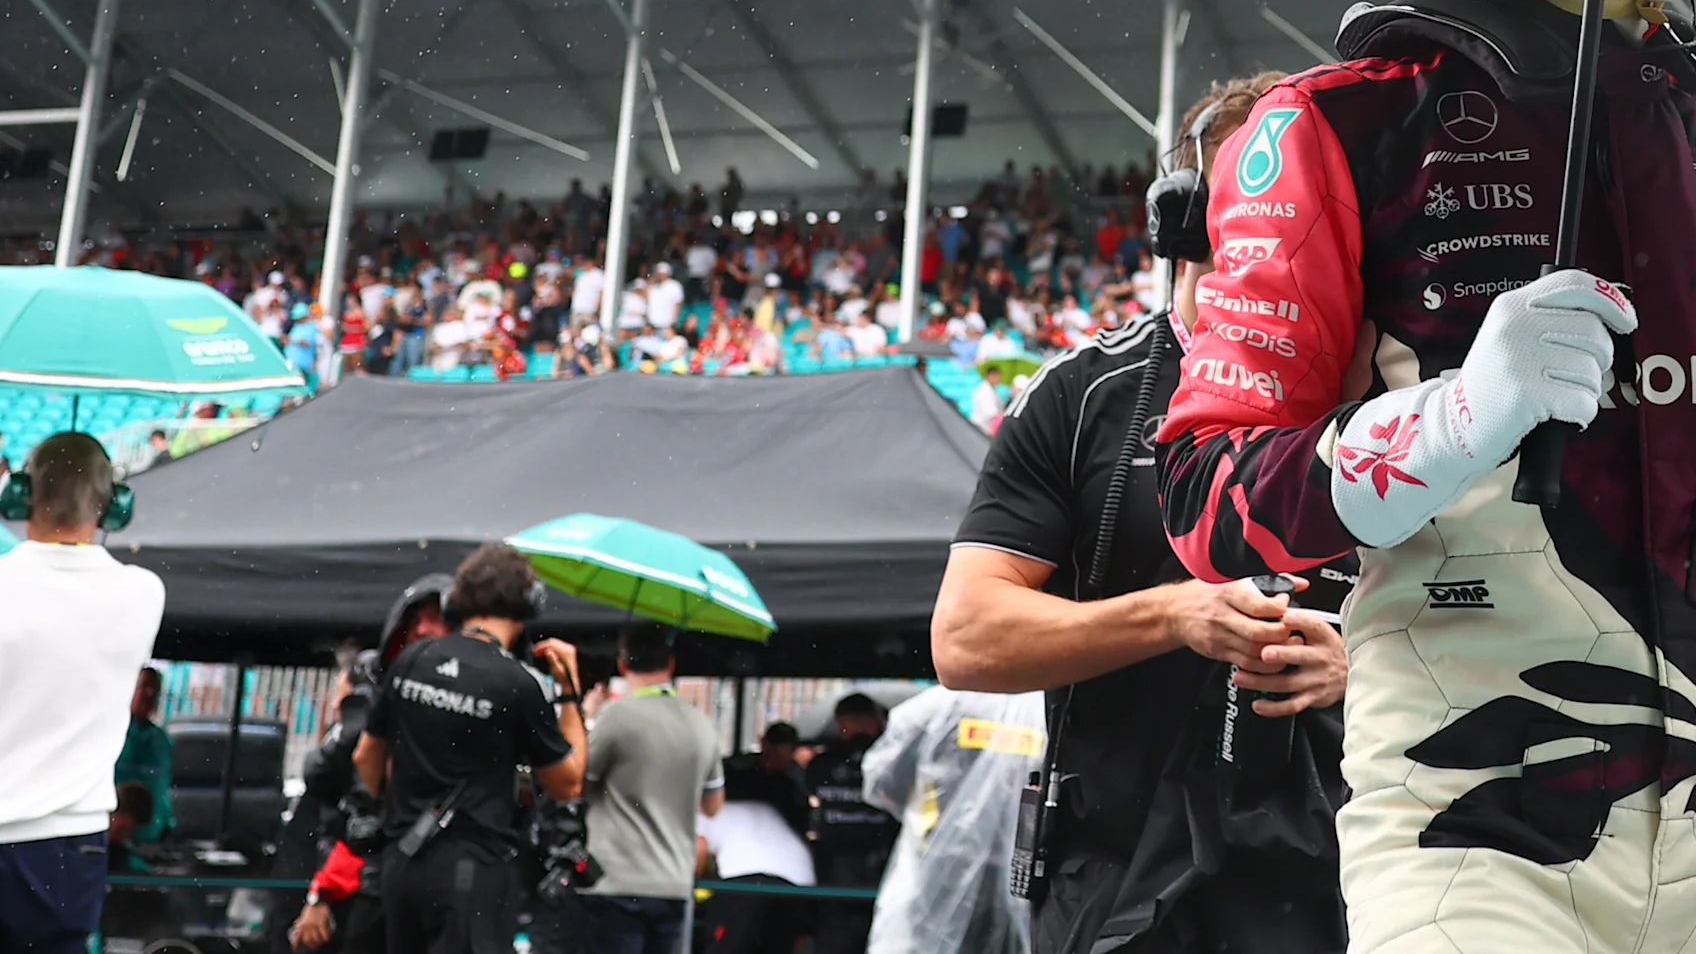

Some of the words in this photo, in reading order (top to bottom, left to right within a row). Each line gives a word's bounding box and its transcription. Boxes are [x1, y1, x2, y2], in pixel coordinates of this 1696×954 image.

[1464, 183, 1534, 210] UBS
[1223, 202, 1296, 219] ETRONAS
[1426, 233, 1551, 256] CROWDSTRIKE
[1195, 285, 1299, 323] Einhell
[1190, 357, 1284, 401] nuvei
[1426, 584, 1491, 603] OMP
[1221, 701, 1239, 763] Russell
